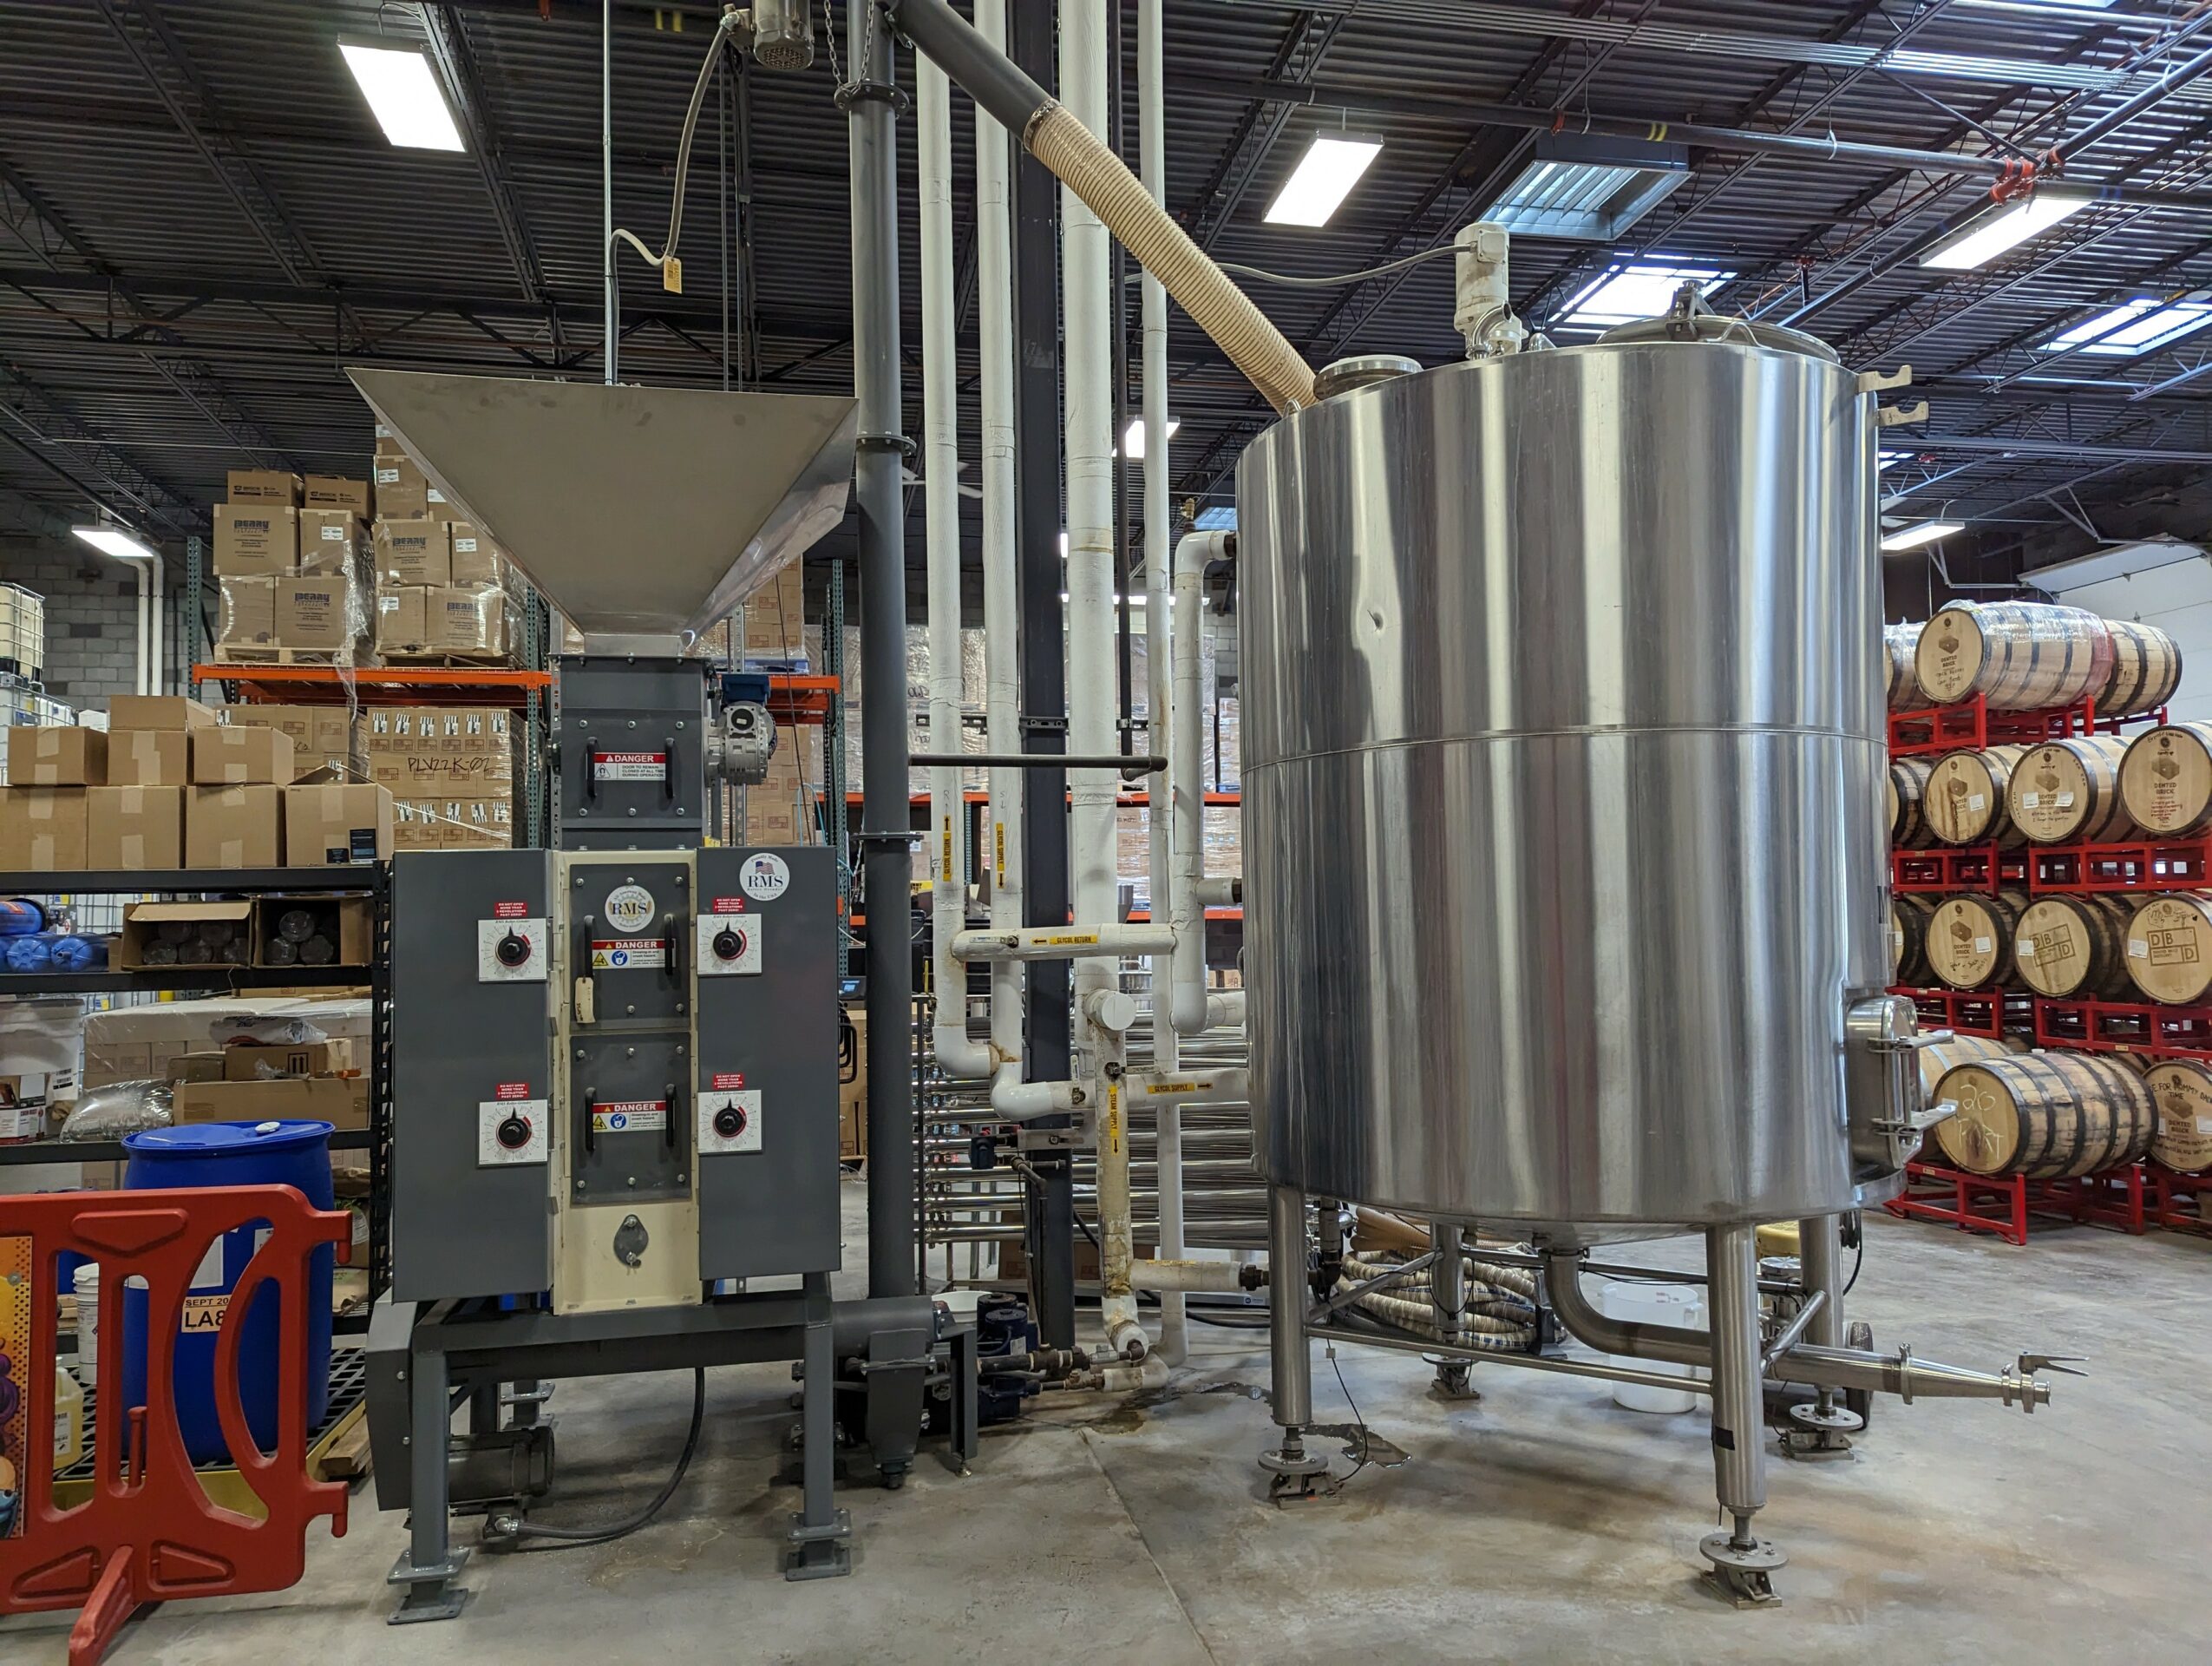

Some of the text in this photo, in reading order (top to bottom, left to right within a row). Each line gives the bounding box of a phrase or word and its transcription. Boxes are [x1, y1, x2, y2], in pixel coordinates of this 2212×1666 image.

[748, 875, 783, 888] RMS
[611, 902, 647, 915] RMS
[2032, 934, 2052, 948] D B
[2151, 933, 2173, 946] D B
[2062, 945, 2070, 955] D
[2185, 948, 2194, 960] D
[2158, 1082, 2171, 1091] FOR
[2174, 1083, 2198, 1094] MOMMY
[2169, 1092, 2184, 1100] TIME
[614, 1103, 657, 1112] DANGER
[185, 1298, 213, 1307] SEPT
